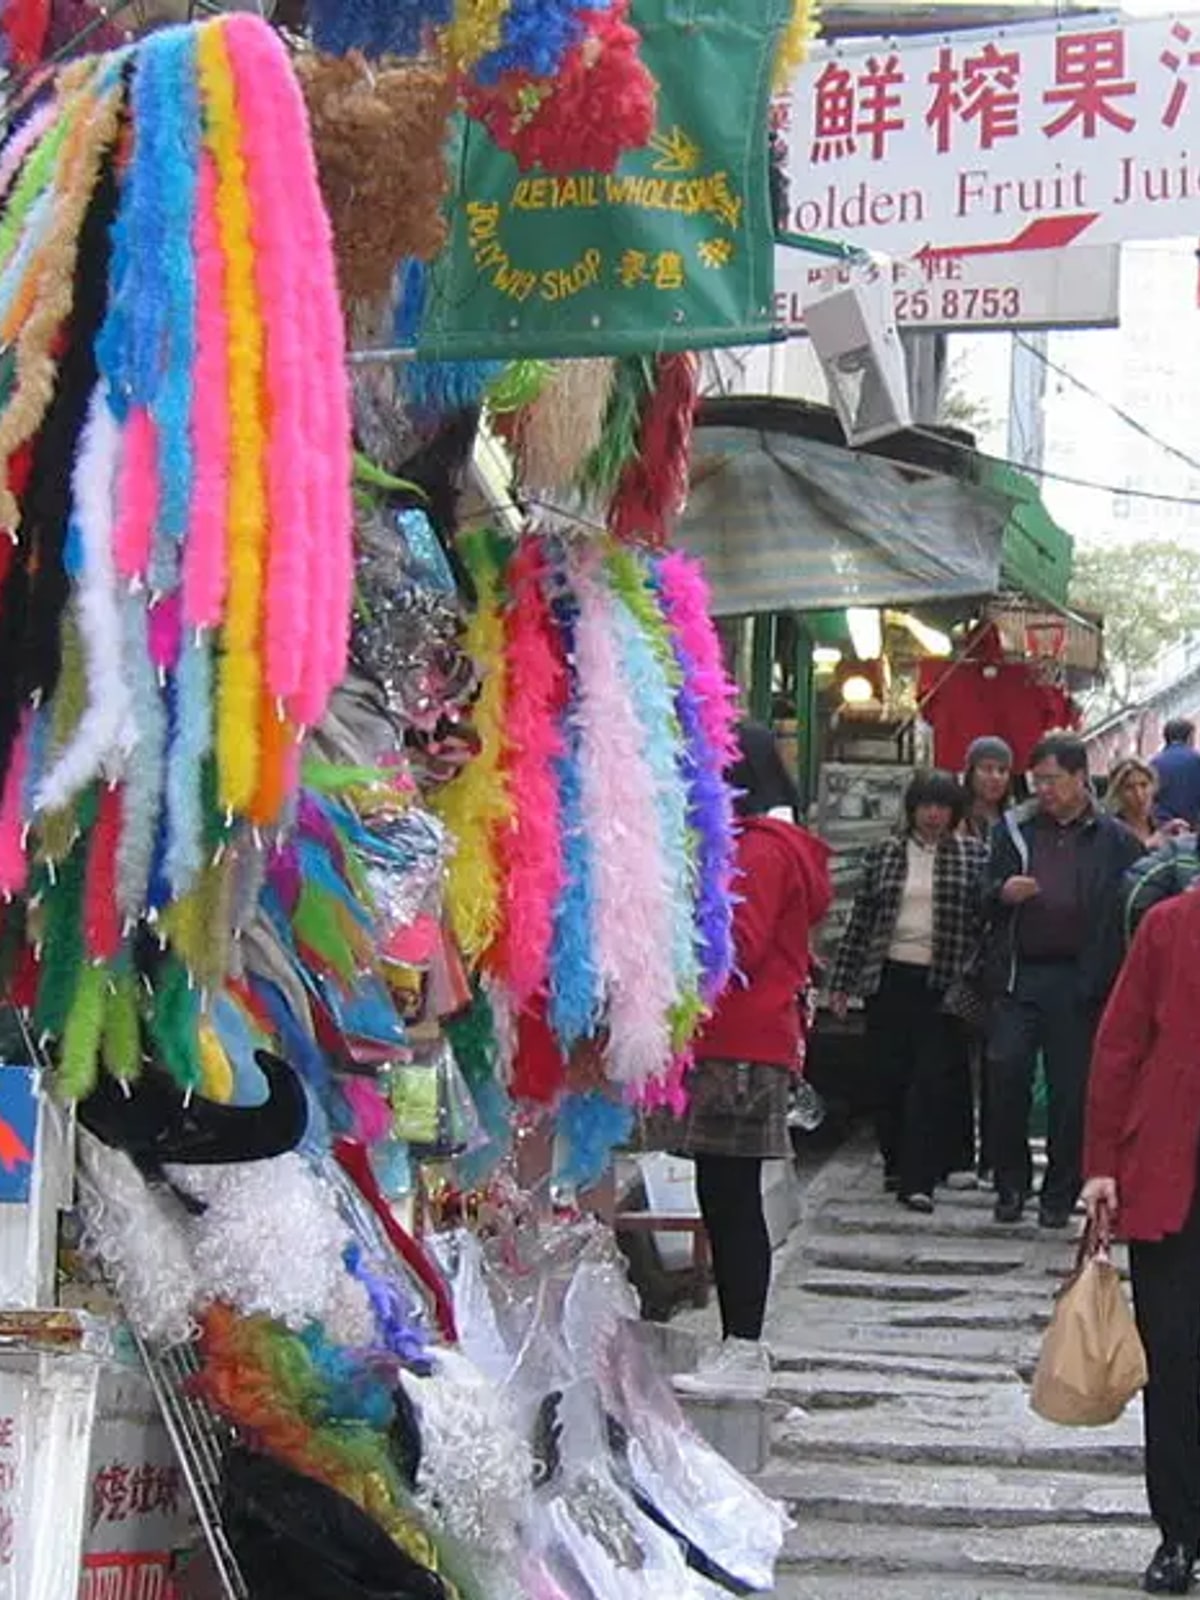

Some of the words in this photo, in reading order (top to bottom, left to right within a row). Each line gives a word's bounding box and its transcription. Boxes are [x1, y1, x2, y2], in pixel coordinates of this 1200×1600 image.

[512, 177, 598, 209] RETAIL
[779, 184, 923, 234] olden
[957, 163, 1087, 217] Fruit
[540, 249, 600, 301] SHOP
[774, 291, 803, 322] EL
[941, 288, 1020, 318] 8753
